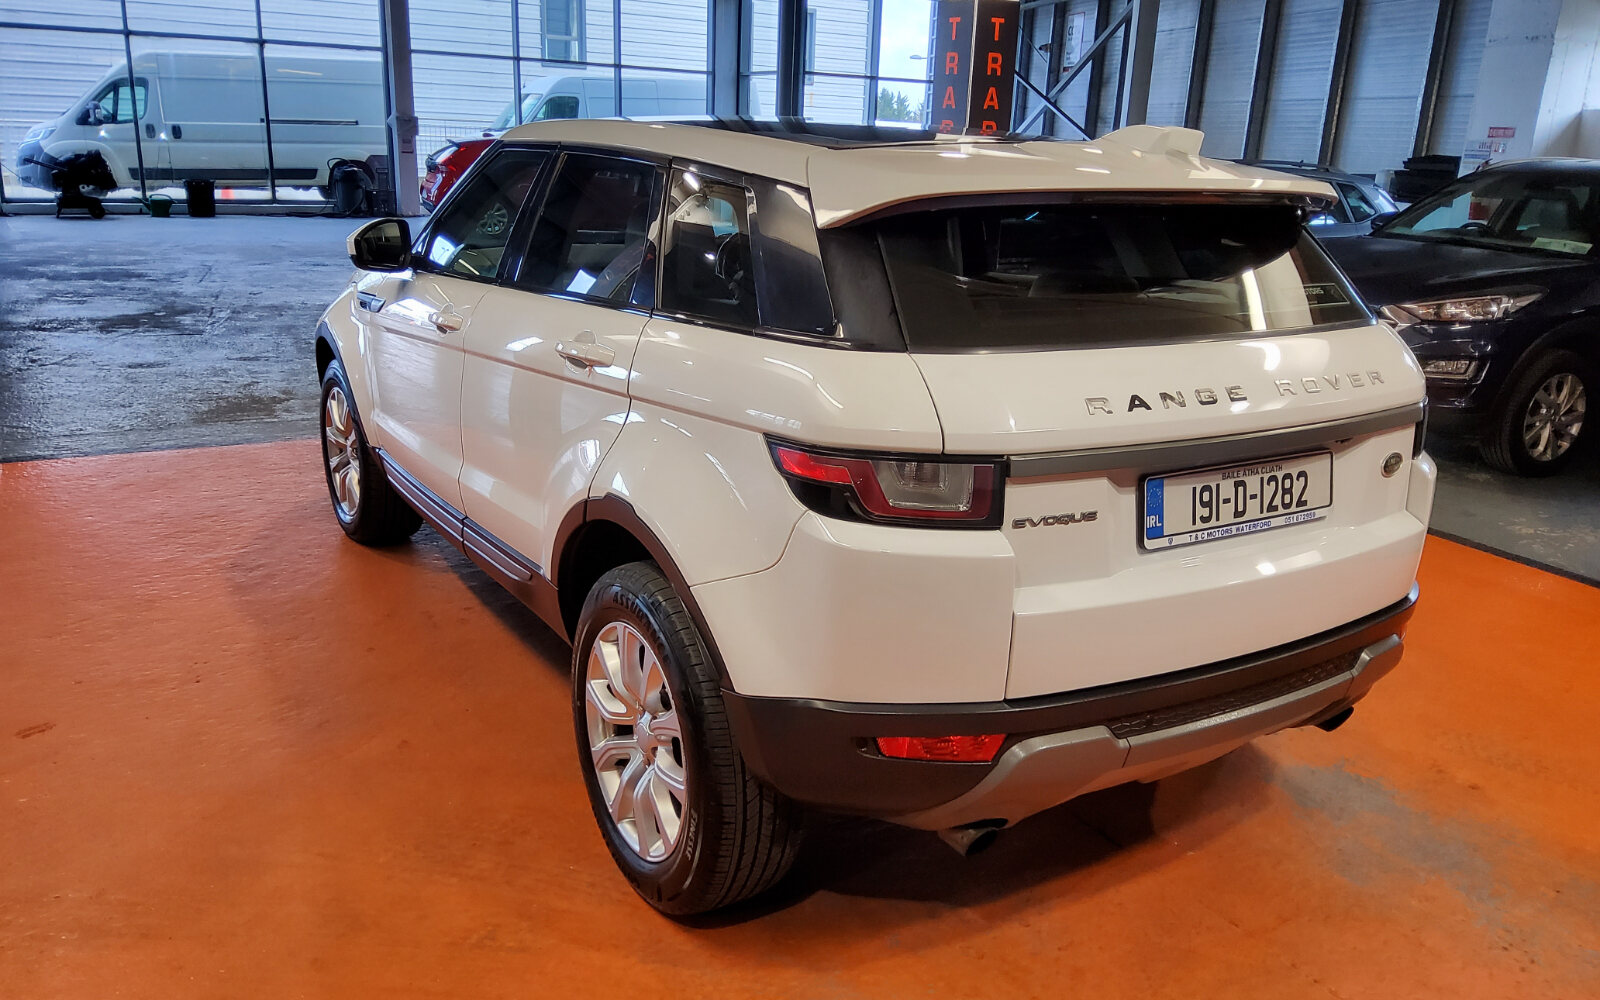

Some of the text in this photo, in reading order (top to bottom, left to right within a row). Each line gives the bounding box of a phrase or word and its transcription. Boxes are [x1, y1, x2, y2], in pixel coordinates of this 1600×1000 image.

[1085, 370, 1385, 416] RANGE ROVER
[1221, 471, 1241, 481] BAILE
[1260, 464, 1283, 475] CLIATH
[1191, 470, 1308, 526] 191-D-1282
[1011, 510, 1098, 529] EVOQUE
[1146, 515, 1162, 529] IRL
[1200, 531, 1206, 540] C
[1206, 527, 1233, 539] MOTORS
[1235, 520, 1272, 534] WATERFORD
